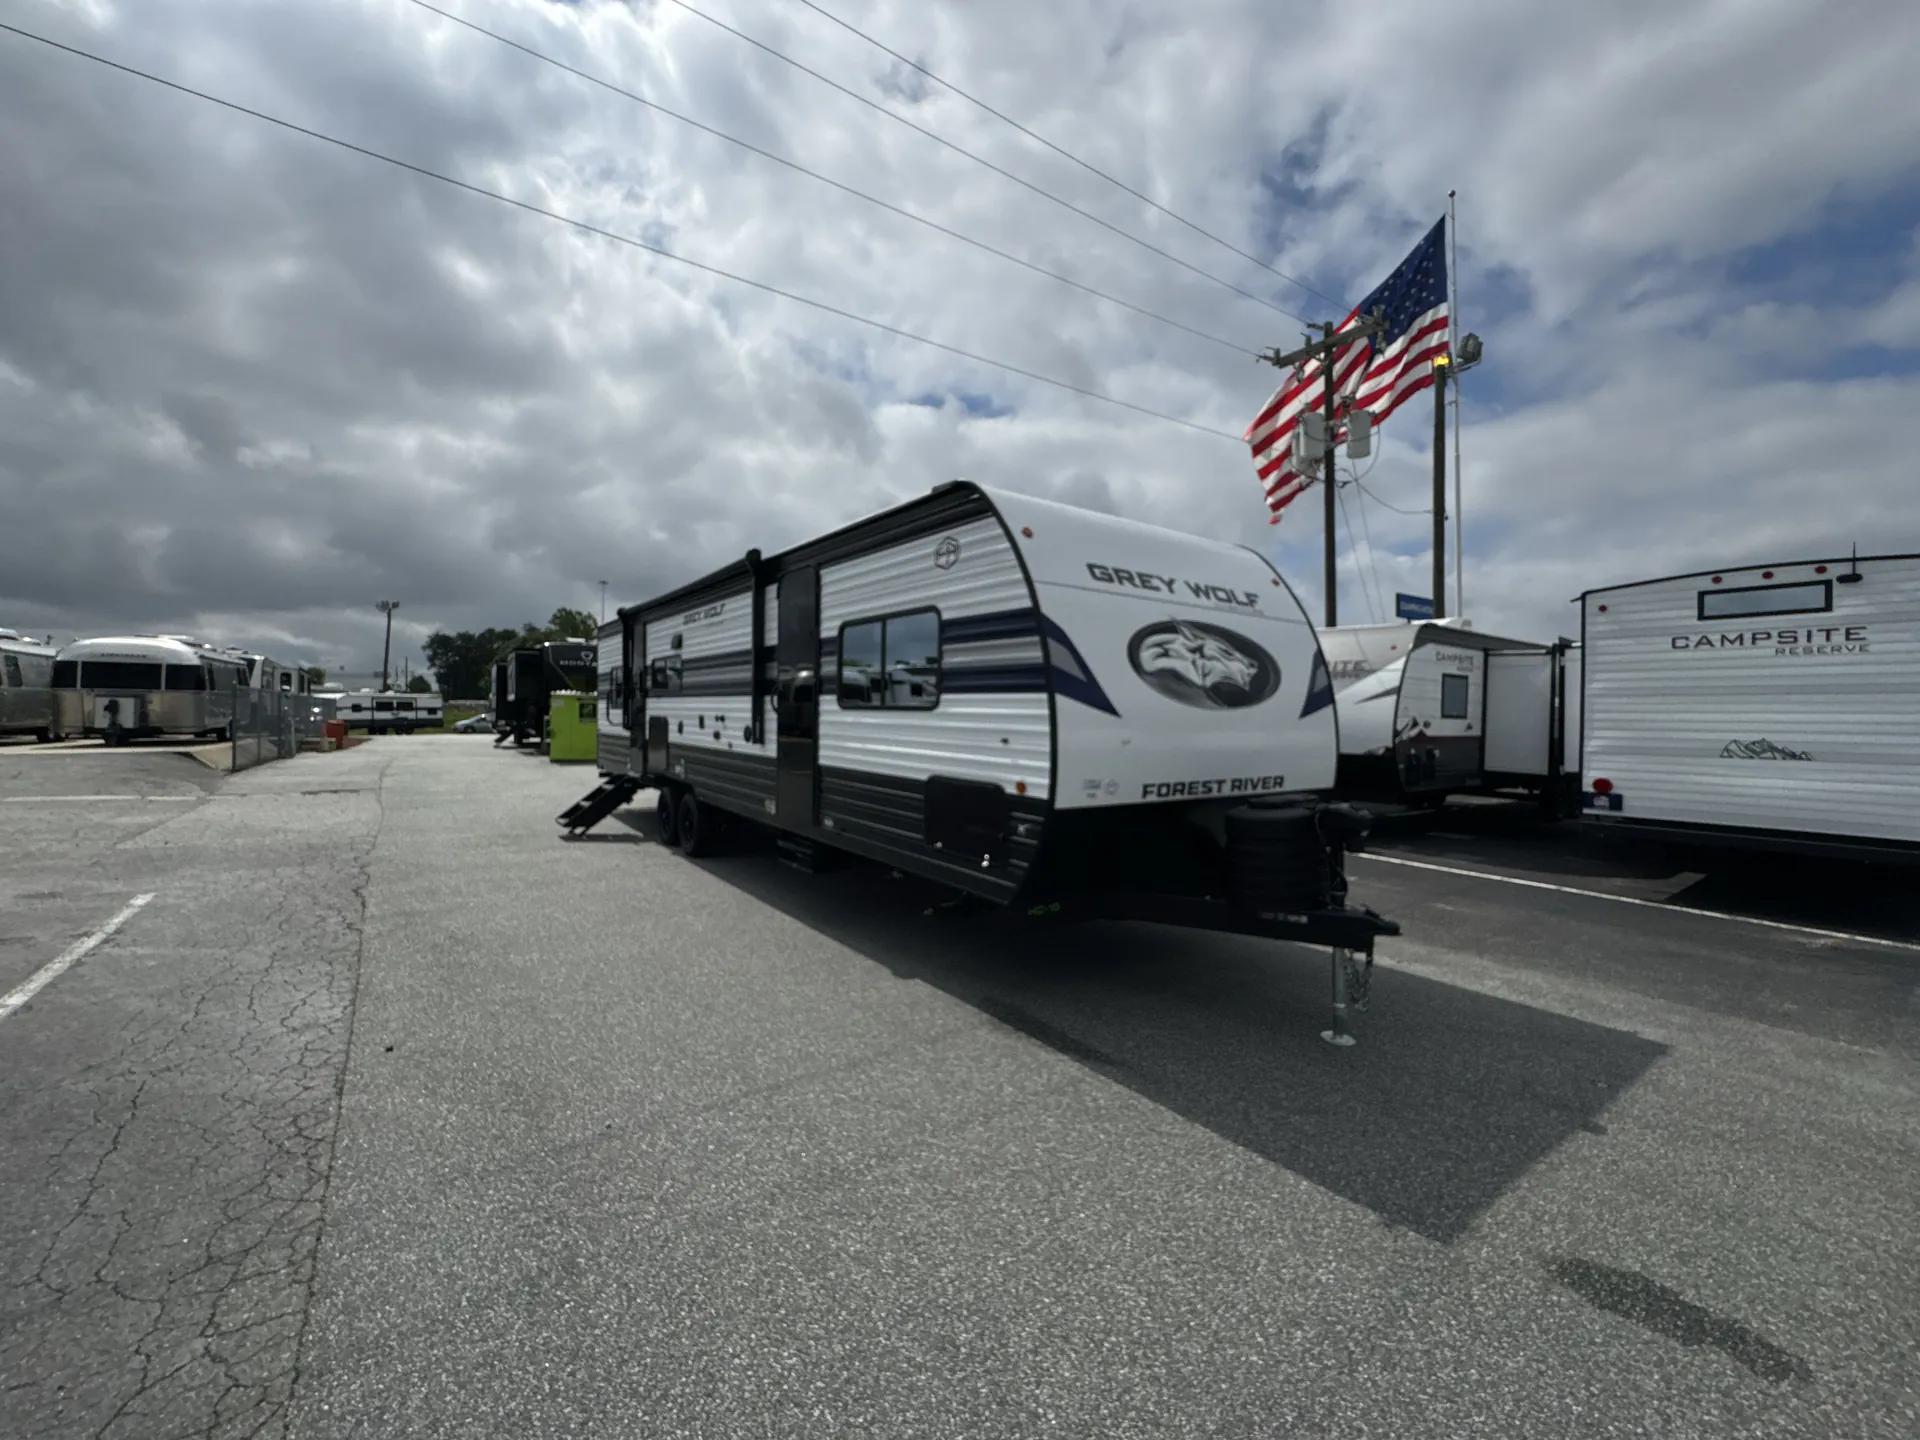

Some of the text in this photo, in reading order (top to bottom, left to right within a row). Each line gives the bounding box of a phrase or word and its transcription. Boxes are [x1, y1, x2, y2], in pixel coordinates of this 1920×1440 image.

[1086, 562, 1260, 608] GREY WOLF
[1671, 626, 1868, 650] CAMPSITE
[1774, 643, 1870, 656] RESERVE
[1142, 775, 1285, 799] FOREST RIVER
